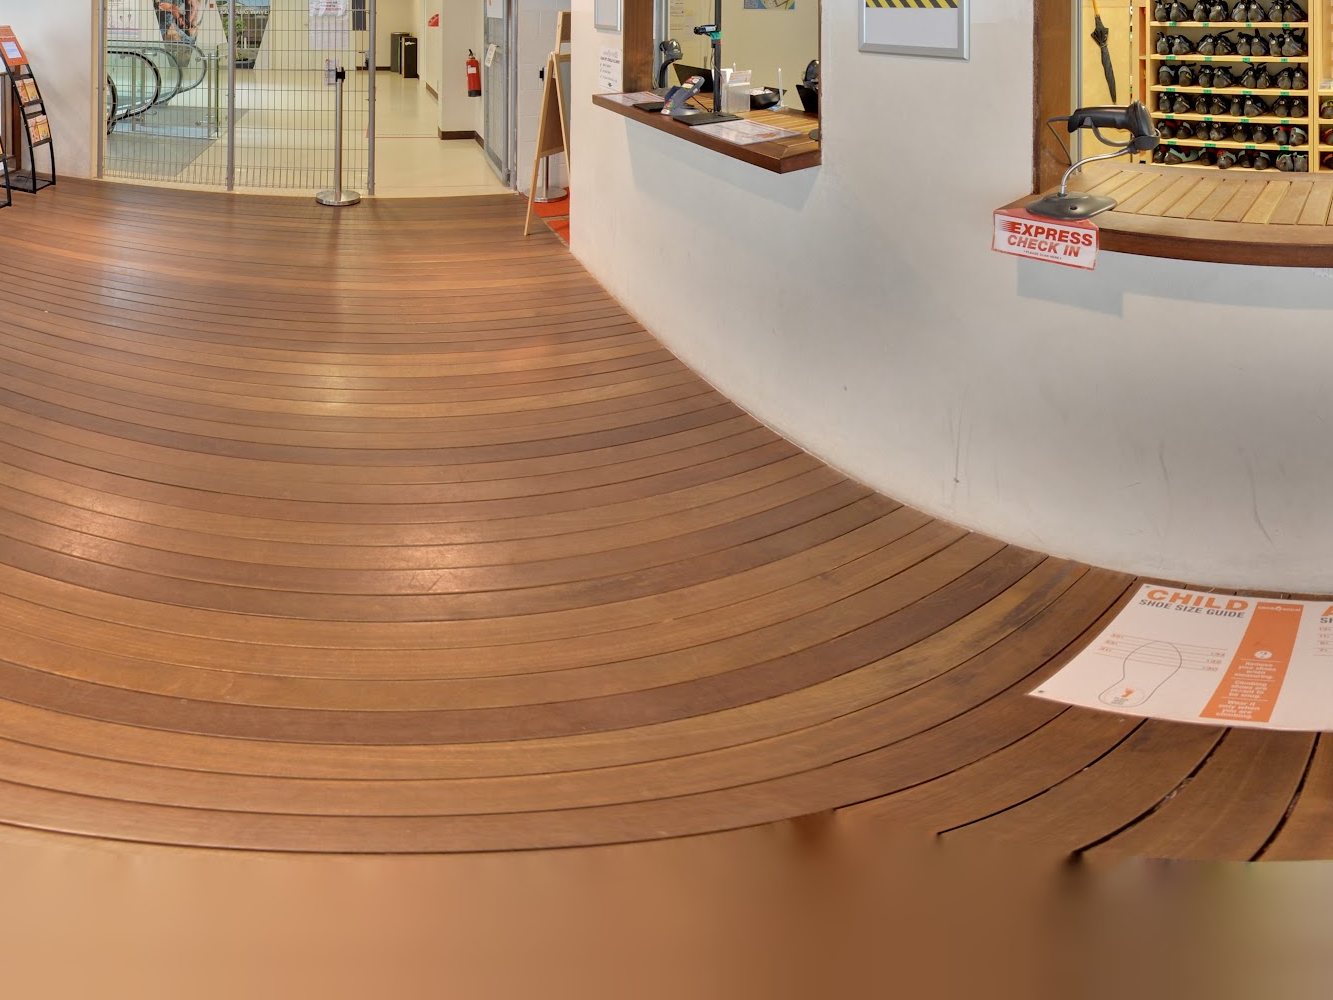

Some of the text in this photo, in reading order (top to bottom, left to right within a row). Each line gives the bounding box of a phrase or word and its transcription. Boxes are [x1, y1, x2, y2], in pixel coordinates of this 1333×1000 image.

[1011, 222, 1092, 246] EXPRESS
[1008, 235, 1081, 257] CHECK IN
[1139, 599, 1245, 618] SHOE SIZE GUIDE
[1147, 589, 1248, 610] CHILD
